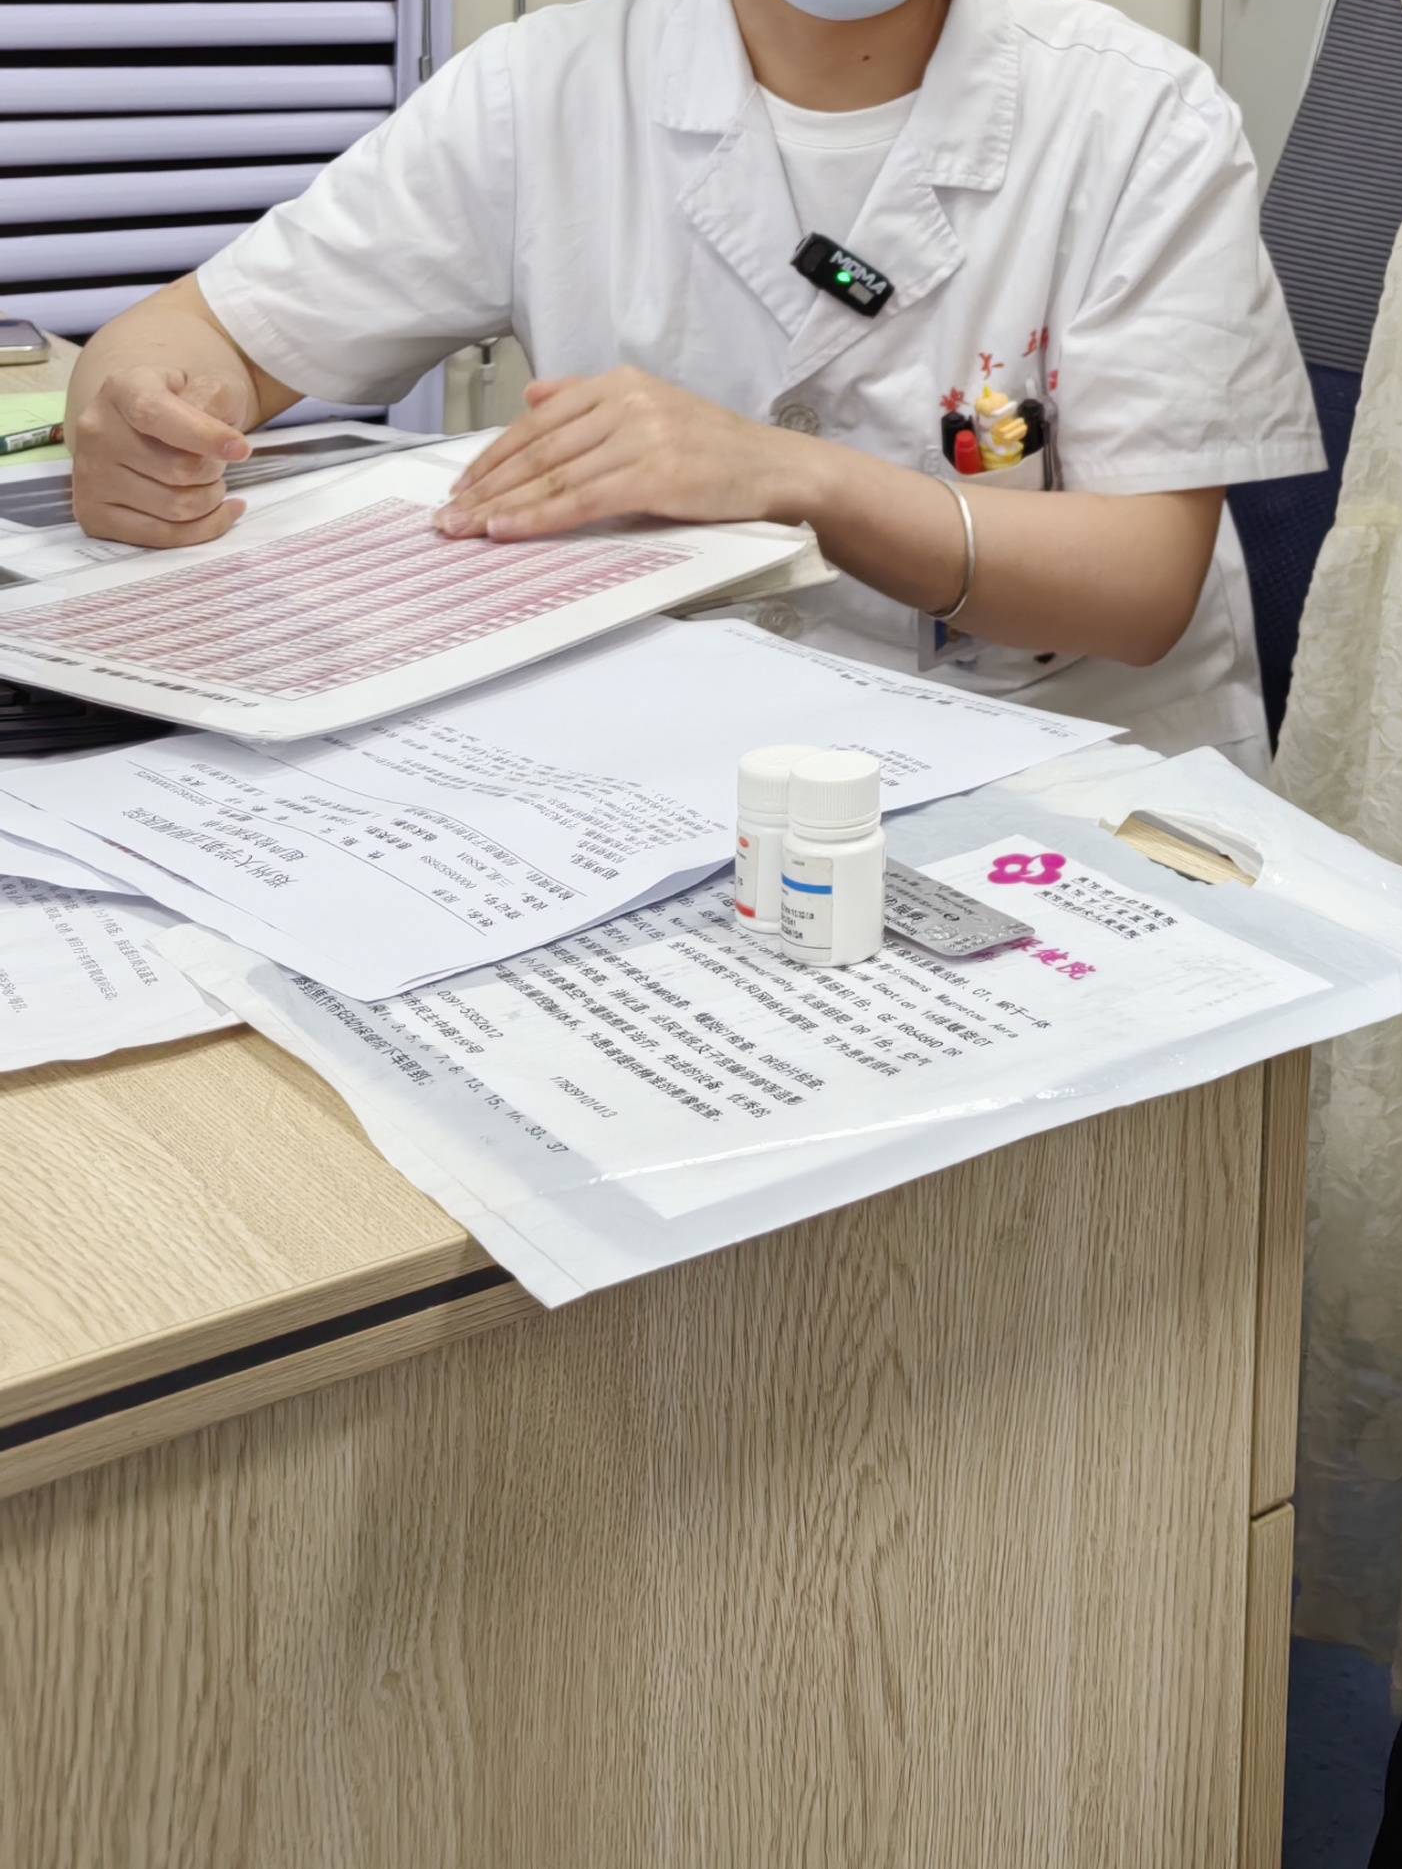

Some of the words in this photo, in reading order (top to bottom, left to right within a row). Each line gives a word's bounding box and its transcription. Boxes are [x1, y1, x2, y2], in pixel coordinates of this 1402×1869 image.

[829, 250, 888, 296] MOMA
[116, 805, 301, 889] 郑州大学第五附属医院
[196, 817, 311, 863] 超声检查报告单
[433, 989, 507, 1040] 0391-5352612
[867, 981, 923, 1011] Emotion
[846, 1023, 874, 1035] DR
[873, 1011, 901, 1024] GE
[937, 1046, 965, 1057] DR
